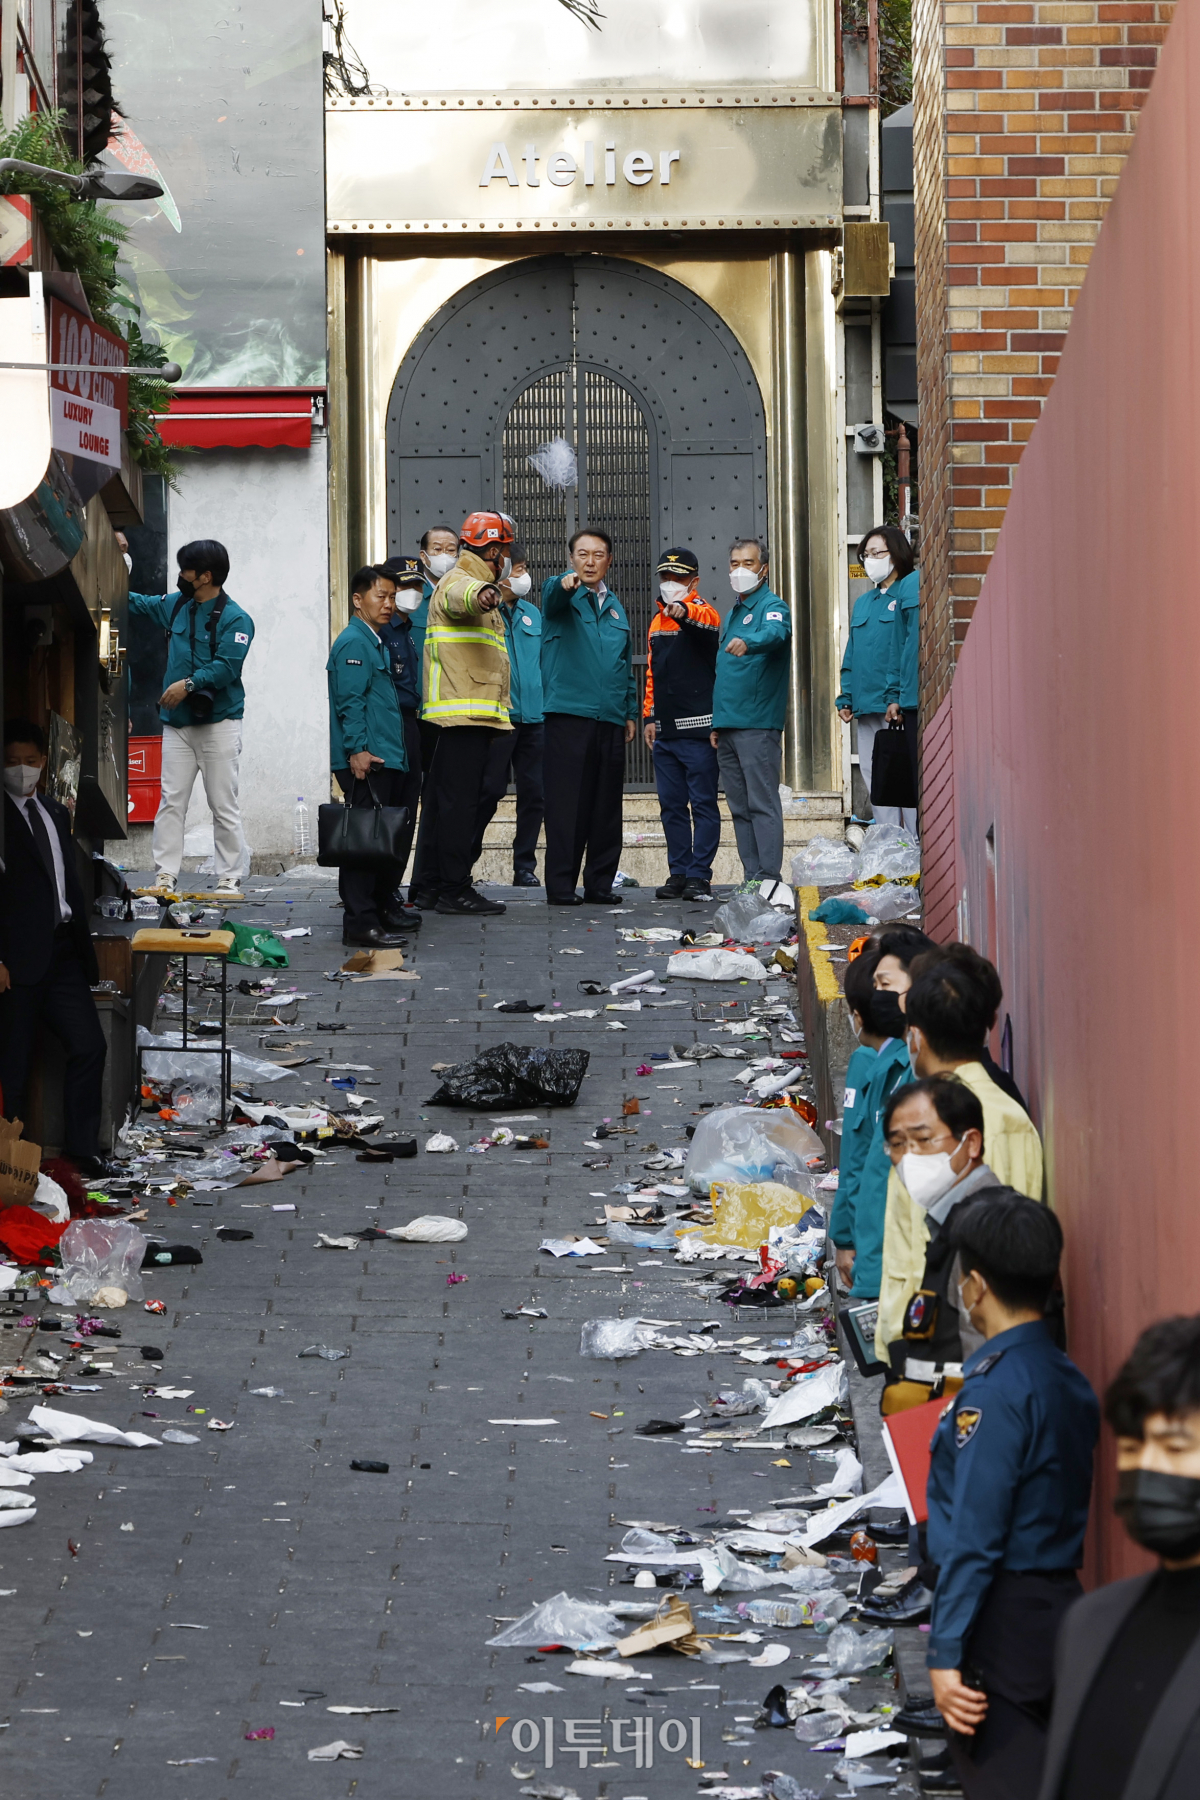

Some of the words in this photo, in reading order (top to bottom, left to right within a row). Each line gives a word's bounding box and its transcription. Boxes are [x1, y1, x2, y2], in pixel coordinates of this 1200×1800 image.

[479, 141, 680, 187] Atelier
[58, 313, 92, 399] 108
[93, 333, 125, 379] HIPHOP
[93, 372, 115, 408] CLUB
[63, 400, 94, 426] LUXURY
[79, 431, 110, 456] LOUNGE
